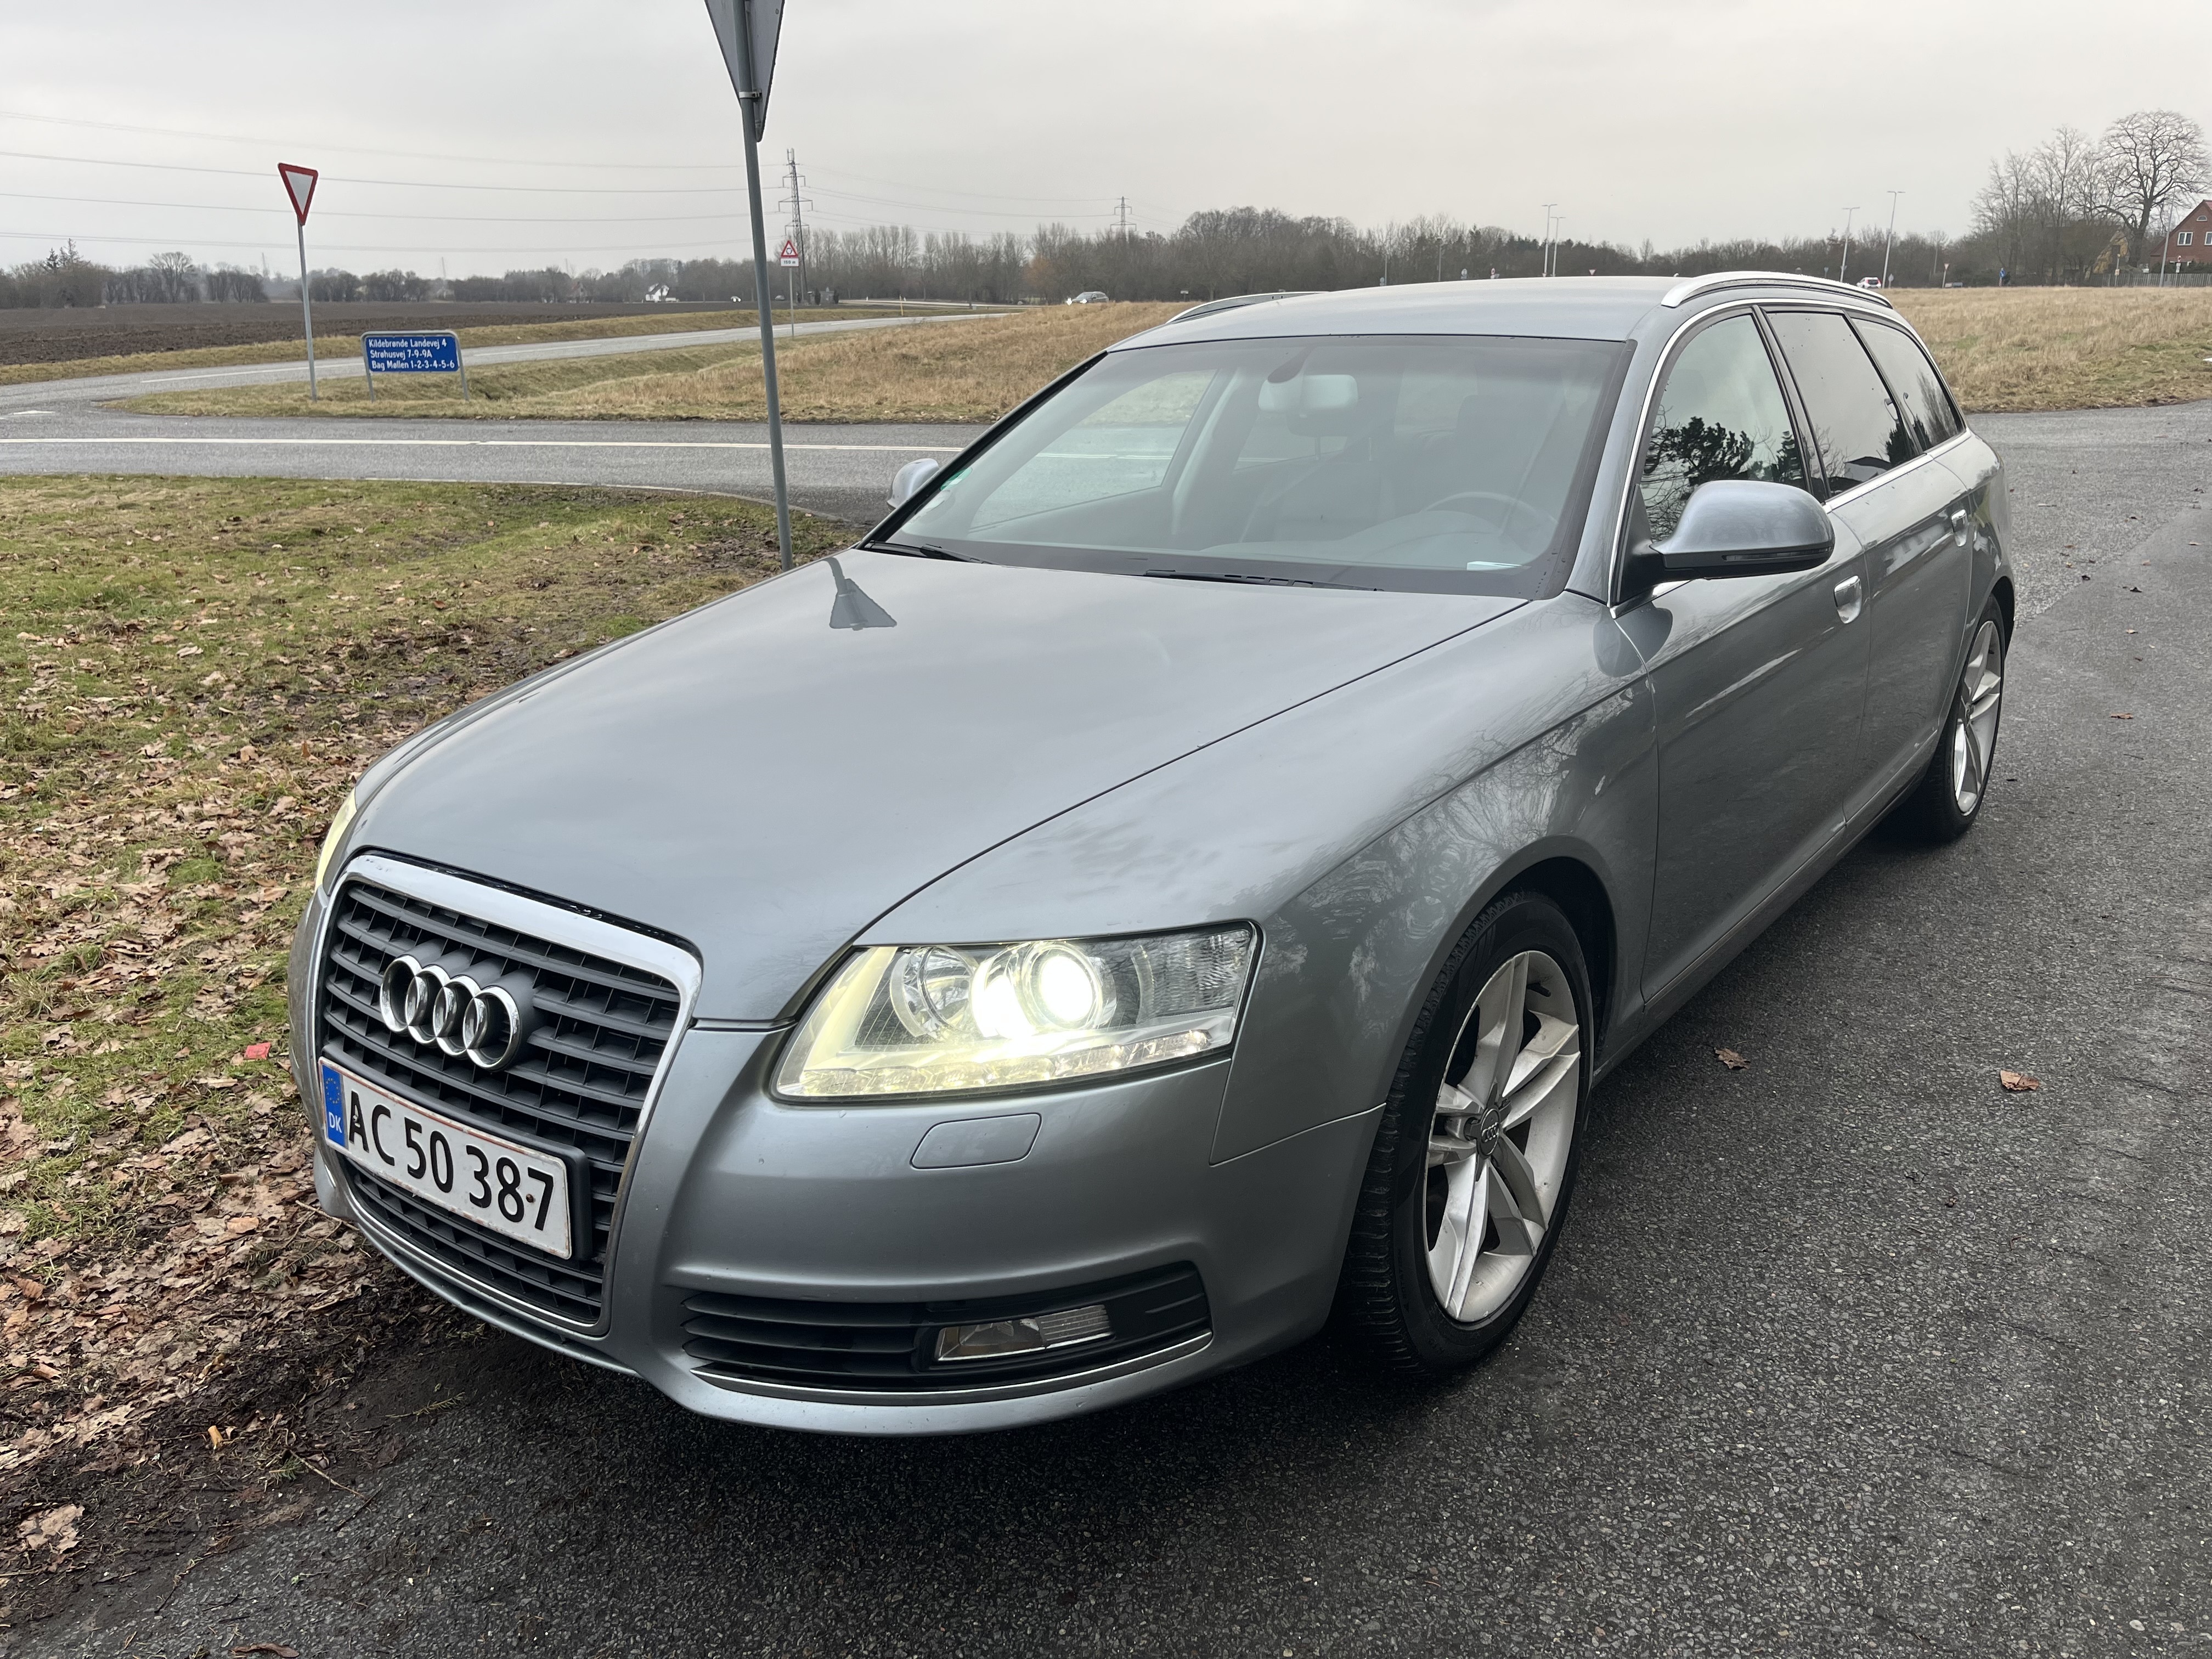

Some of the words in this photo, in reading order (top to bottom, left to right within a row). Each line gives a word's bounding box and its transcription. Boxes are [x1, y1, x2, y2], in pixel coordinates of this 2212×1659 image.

[369, 338, 408, 348] Kildebrønde
[410, 338, 440, 350] Landevej
[442, 338, 447, 347] 4
[370, 349, 406, 361] Strøhusvej
[407, 349, 433, 358] 7-9-9A
[371, 360, 385, 371] Bag
[386, 360, 409, 369] Møllen
[410, 360, 455, 369] 1-2-3-4-5-6
[328, 1111, 343, 1133] DK
[349, 1090, 395, 1167] AC
[404, 1117, 454, 1193] 50
[466, 1144, 554, 1232] 387
